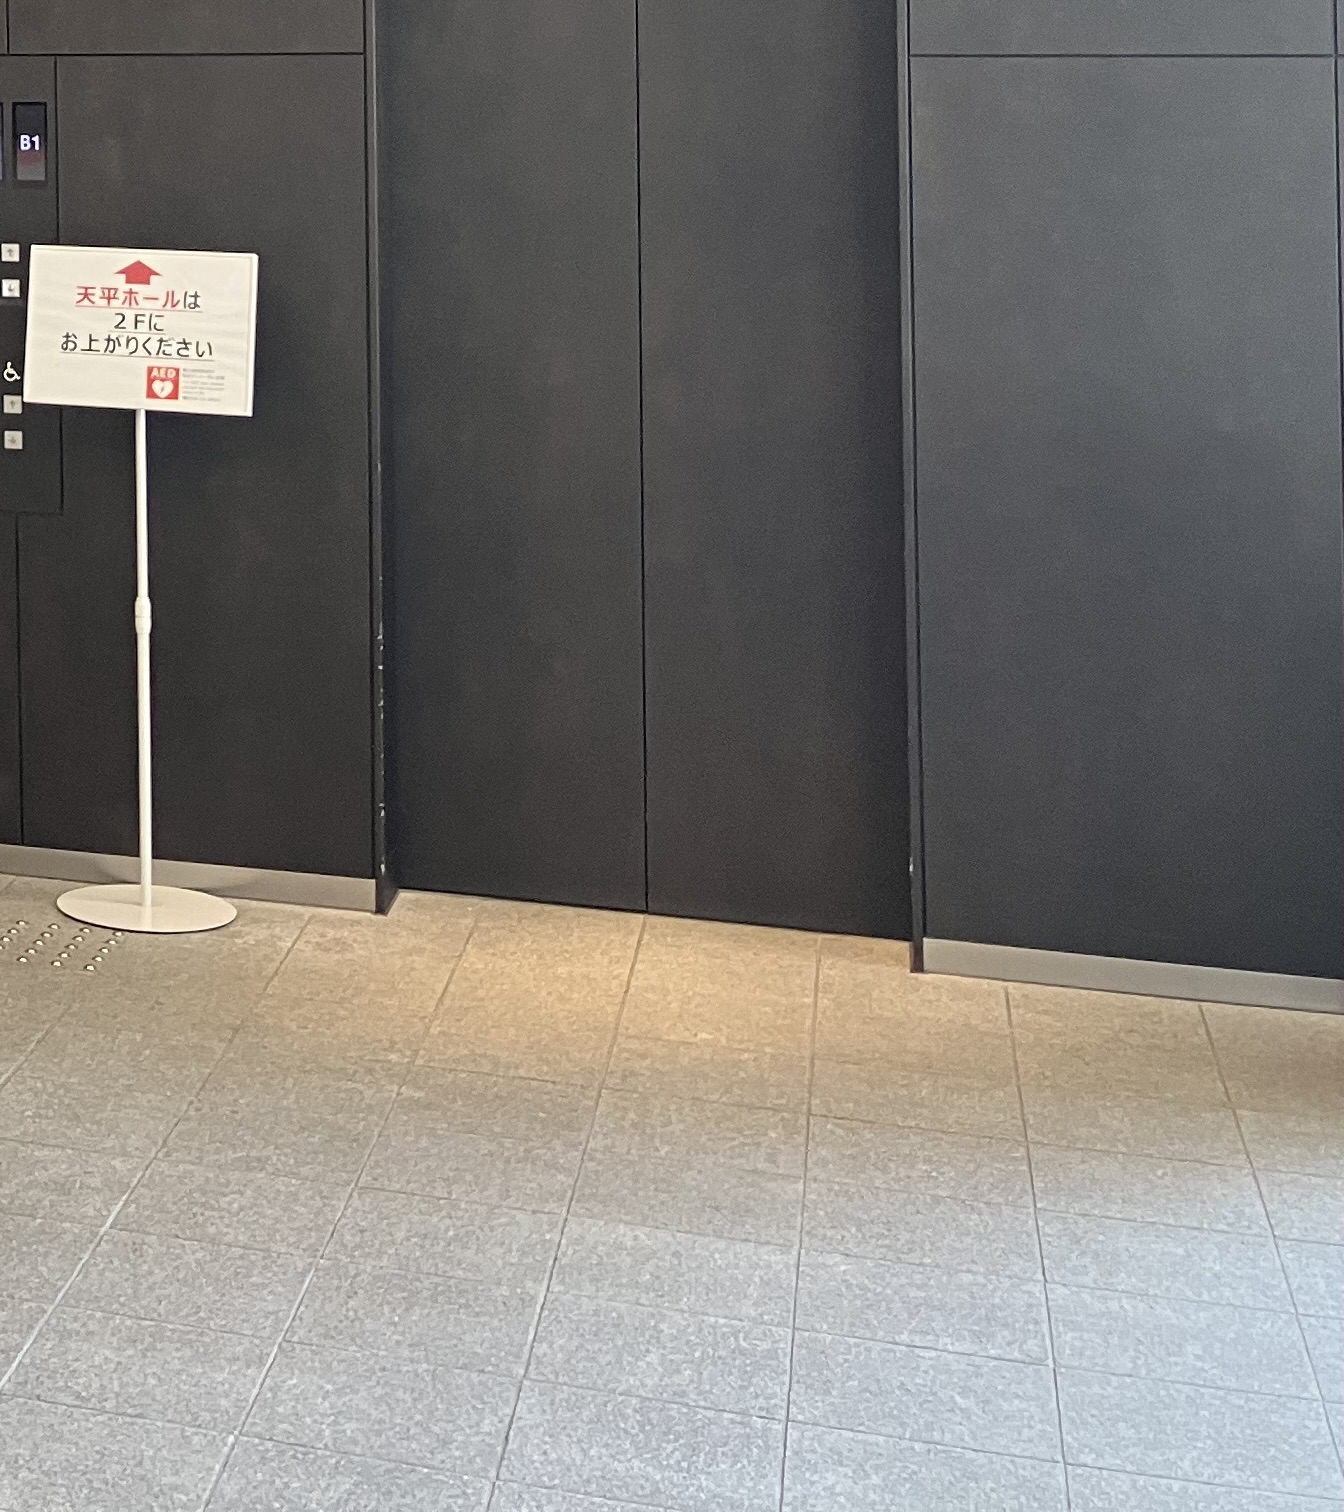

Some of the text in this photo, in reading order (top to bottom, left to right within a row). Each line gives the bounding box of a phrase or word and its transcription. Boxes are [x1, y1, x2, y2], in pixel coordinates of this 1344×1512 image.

[20, 134, 40, 151] B1
[75, 285, 202, 310] 天平ホールは
[113, 312, 166, 332] 2Fに
[60, 332, 214, 358] お上がりください
[151, 367, 177, 379] AED
